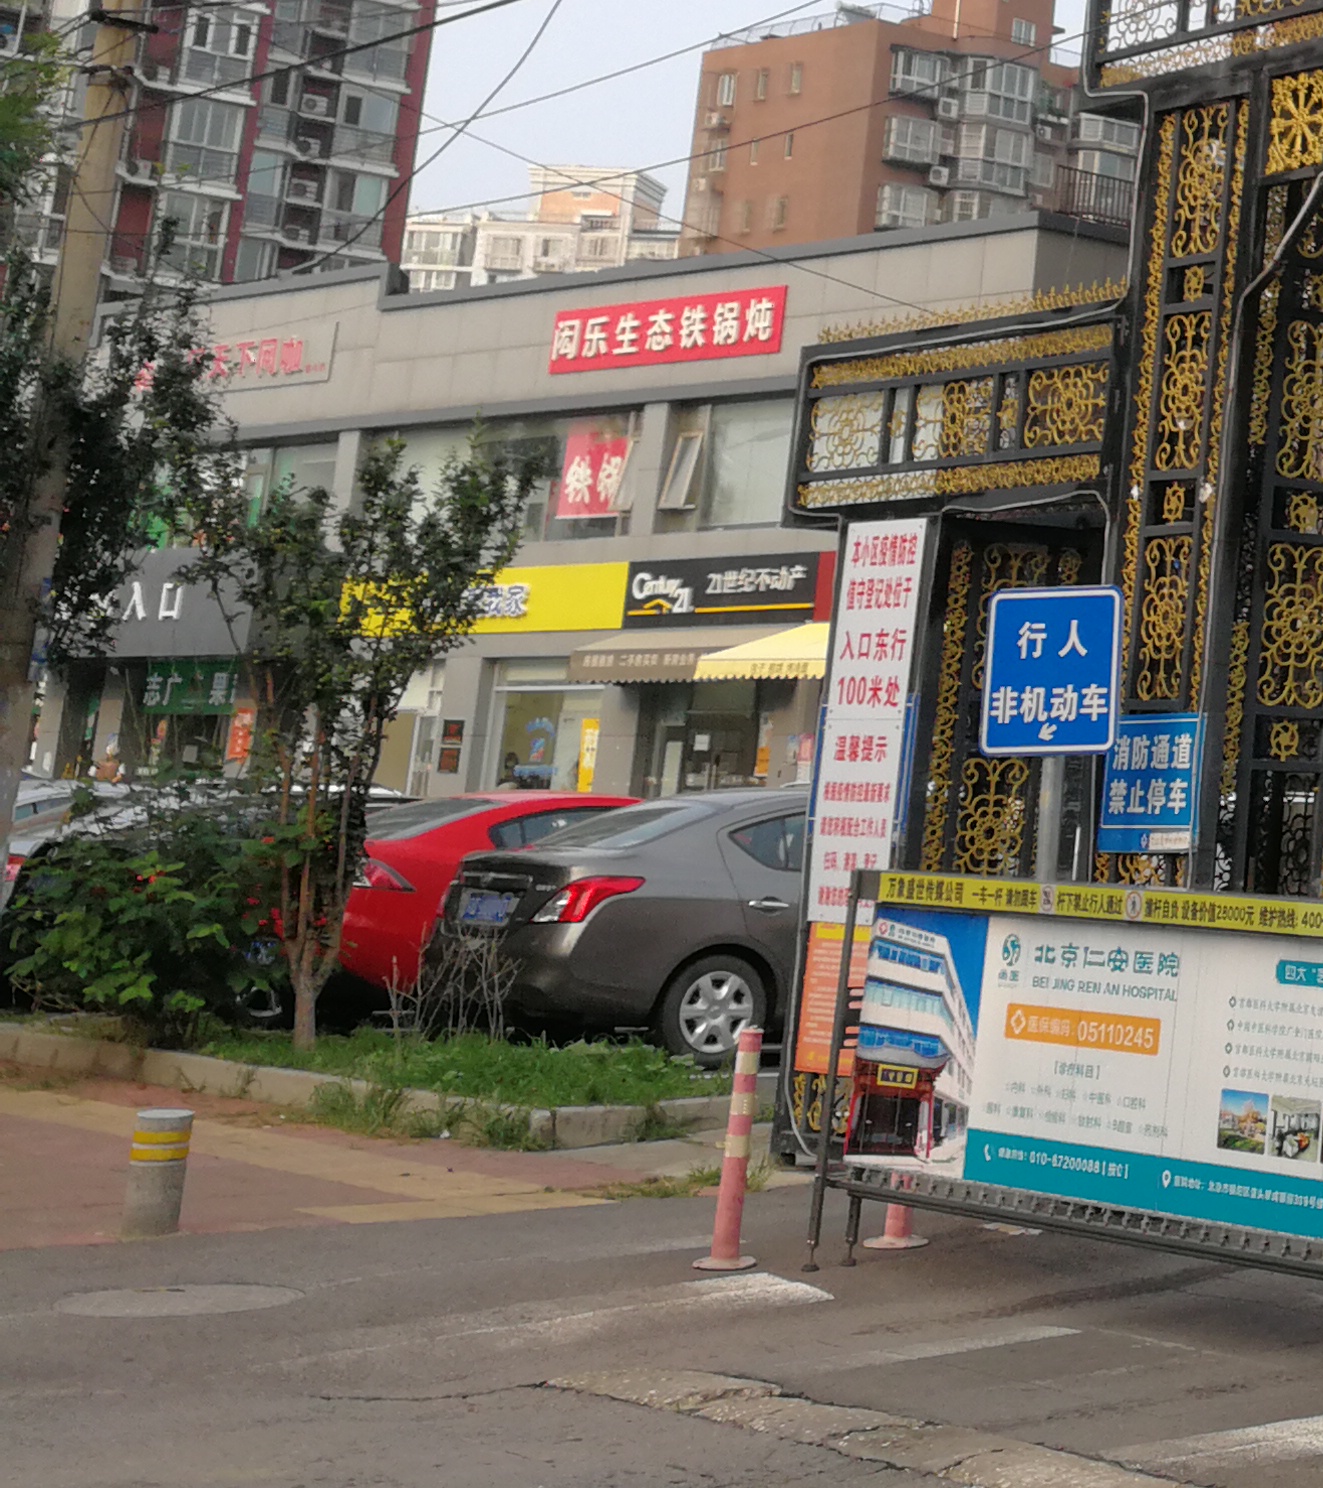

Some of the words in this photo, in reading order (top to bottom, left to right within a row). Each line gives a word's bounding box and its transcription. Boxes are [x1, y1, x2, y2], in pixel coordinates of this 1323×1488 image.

[851, 533, 918, 567] 本小区疫情防控
[705, 565, 808, 595] 21世纪不动产
[839, 628, 908, 662] 入口东行
[1017, 619, 1088, 659] 行人
[837, 675, 900, 709] 100米处
[990, 684, 1109, 724] 非机动车
[1112, 733, 1192, 772] 消防通道
[1109, 778, 1188, 815] 禁止停车
[886, 877, 964, 904] 万象盛世传媒公司
[1034, 942, 1180, 978] 北京仁安医院
[1077, 981, 1100, 994] REN
[1103, 982, 1120, 996] AN
[1122, 984, 1178, 1002] HOSPITAL
[1077, 1020, 1154, 1049] 05110245
